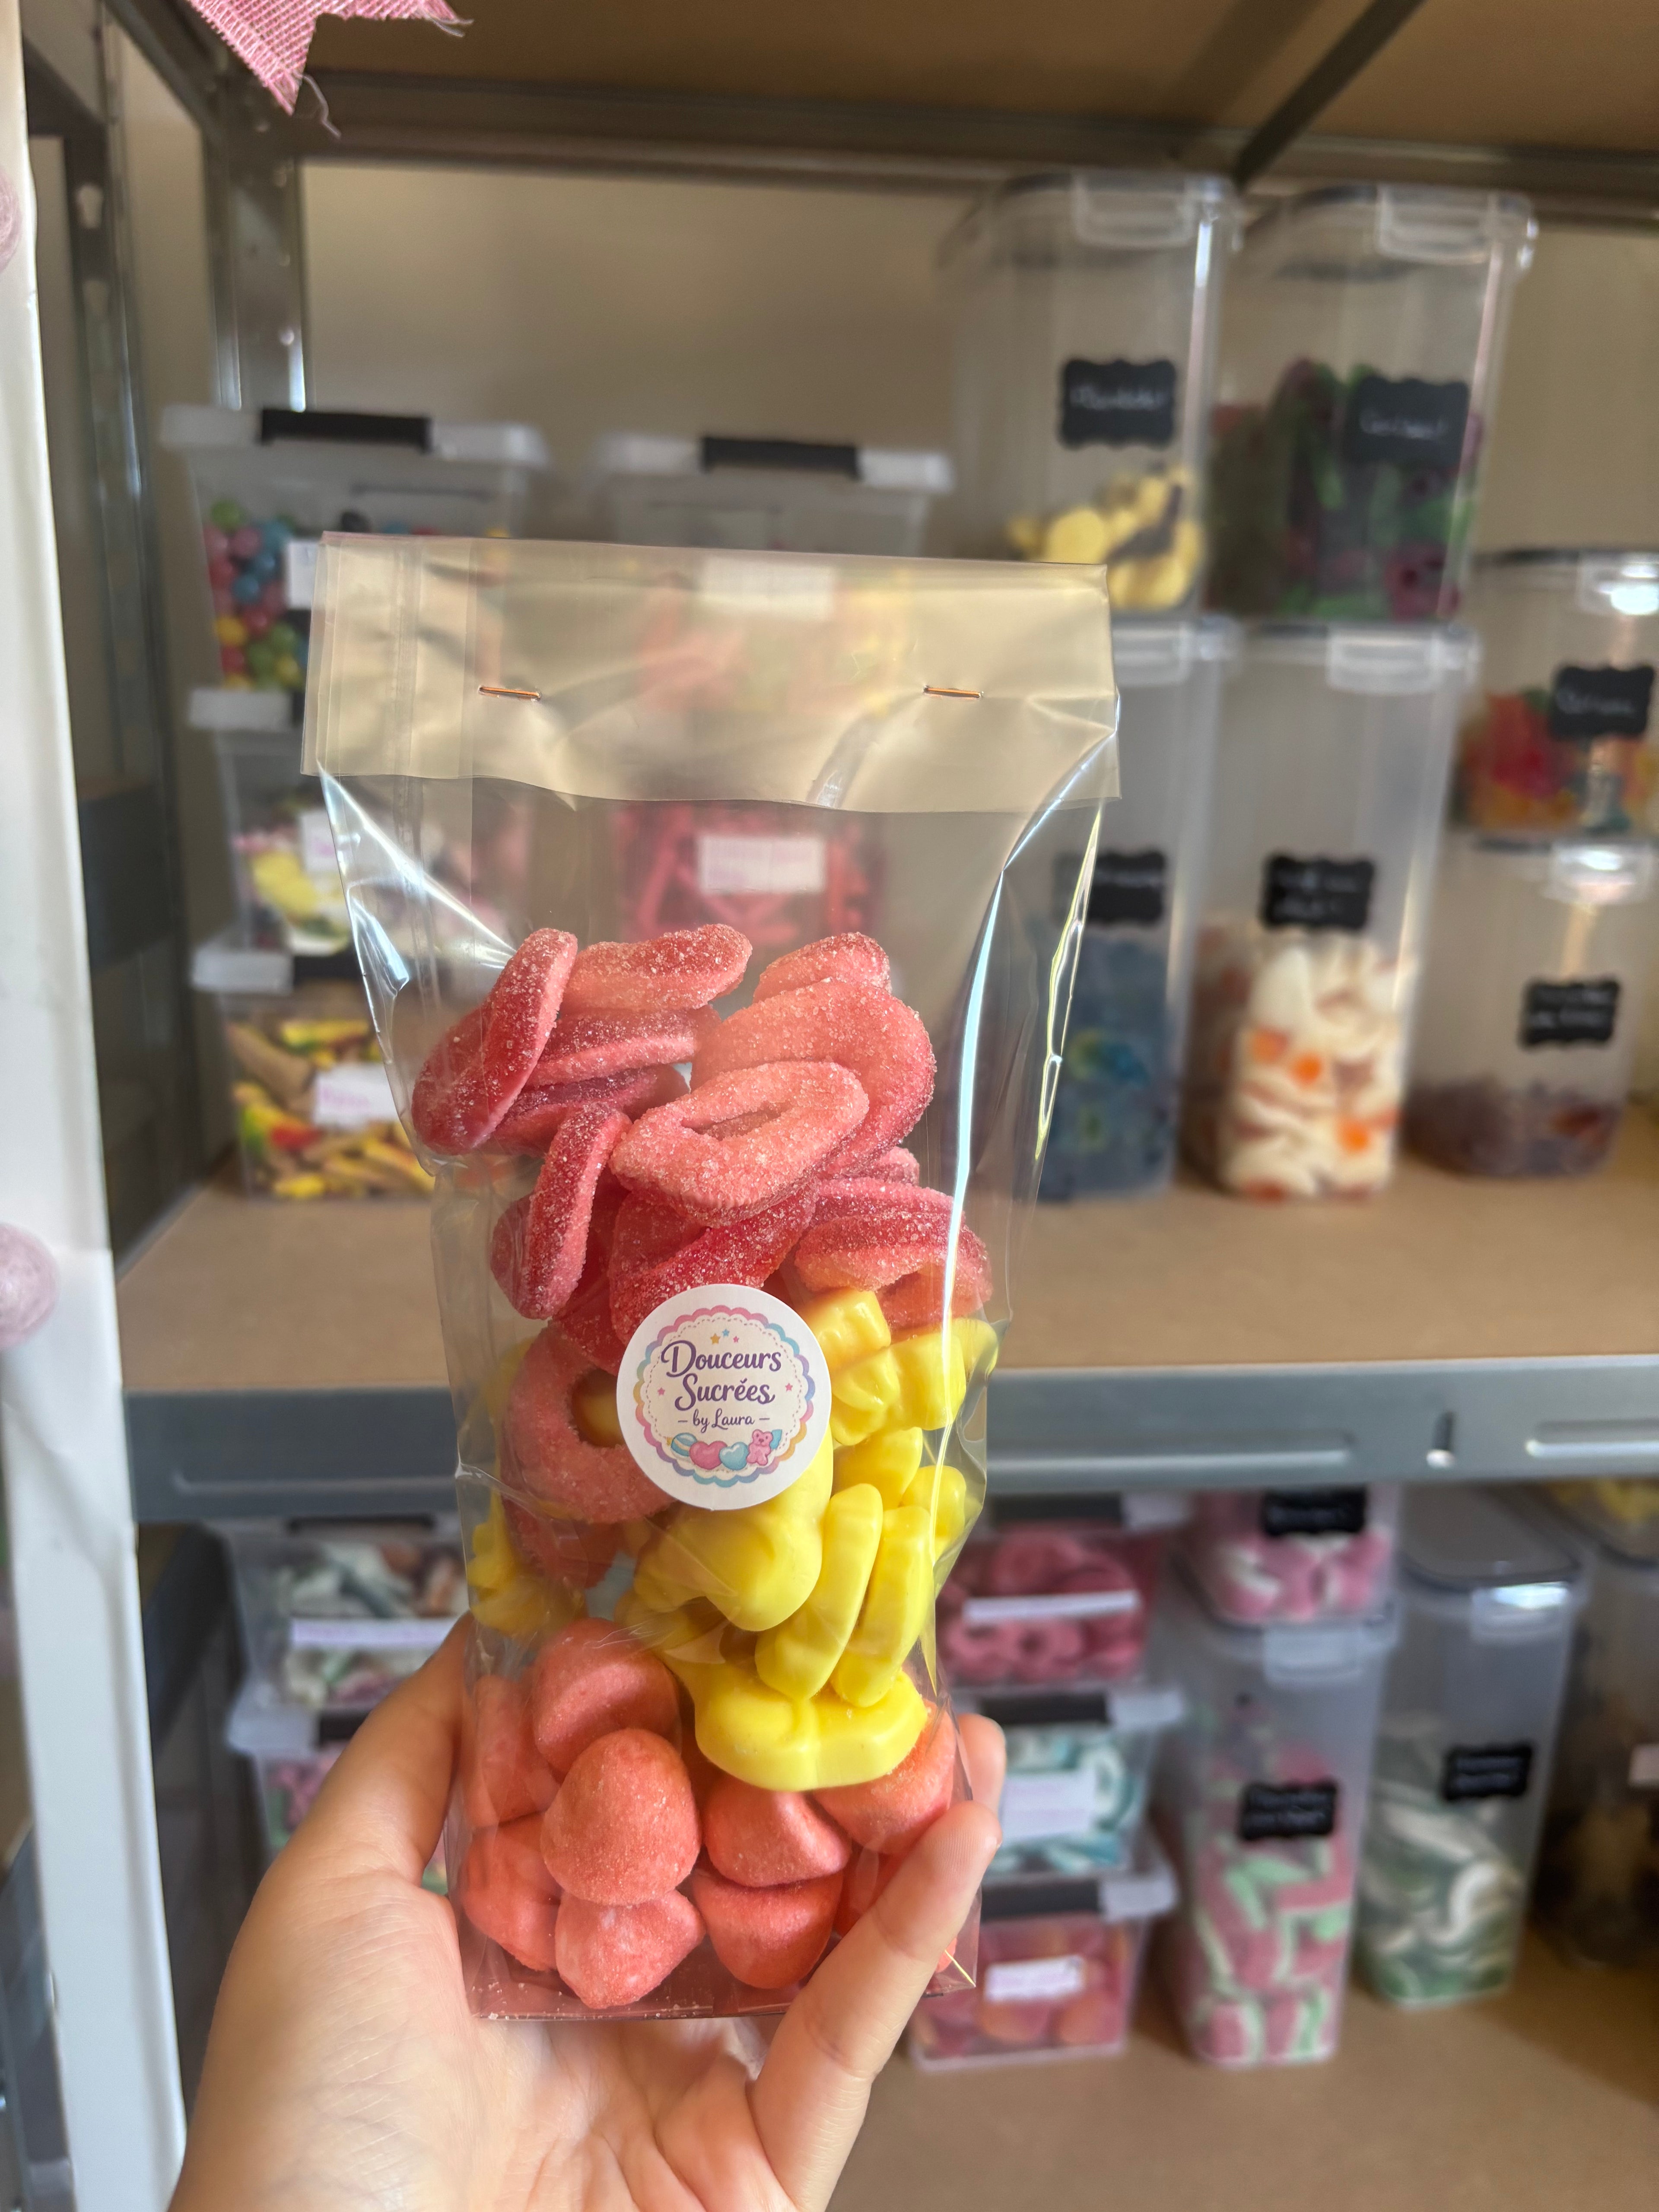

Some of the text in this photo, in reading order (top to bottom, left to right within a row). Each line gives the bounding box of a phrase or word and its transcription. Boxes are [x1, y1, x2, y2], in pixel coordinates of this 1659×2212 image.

[660, 1339, 782, 1378] Douceurs
[674, 1373, 776, 1411] Sucrées
[692, 1408, 755, 1433] by Laura
